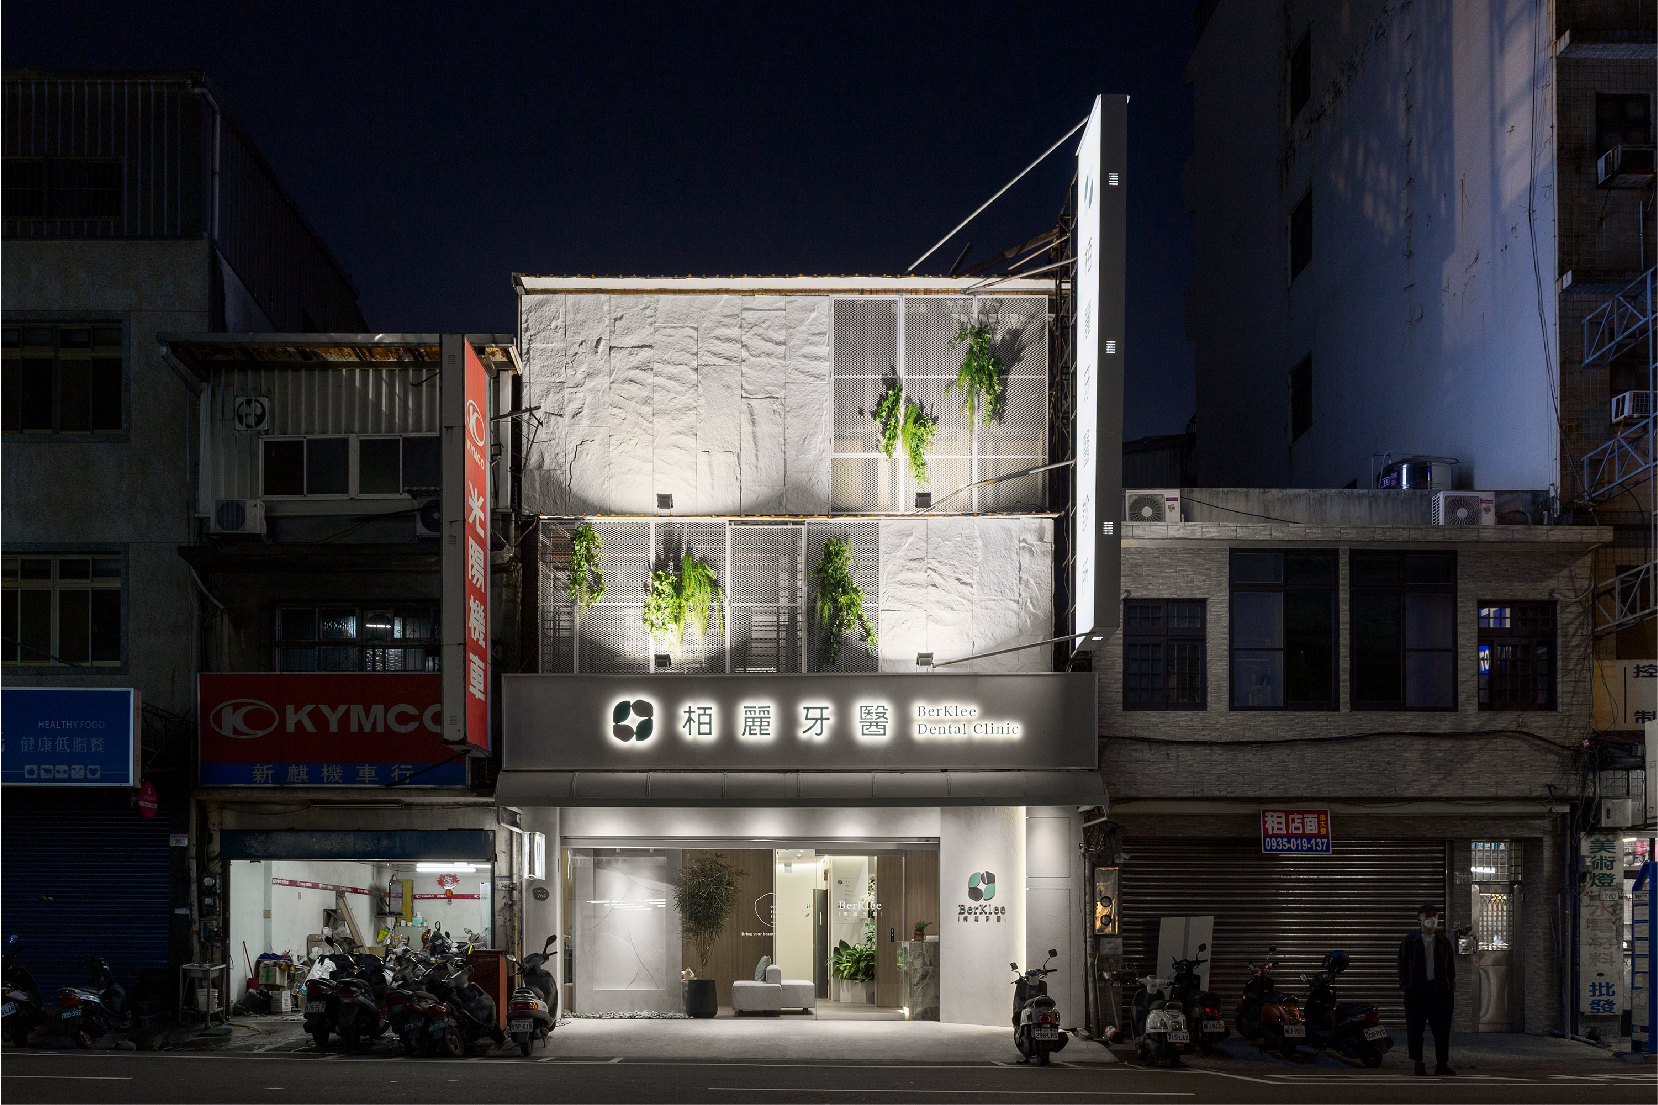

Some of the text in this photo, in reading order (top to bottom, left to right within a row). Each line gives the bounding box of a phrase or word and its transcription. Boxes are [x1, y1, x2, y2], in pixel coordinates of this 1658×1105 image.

[467, 439, 485, 470] KYMCO
[467, 480, 486, 702] 光陽機車
[916, 705, 977, 718] BerKlee
[38, 720, 106, 729] HEALTHY FOOD
[916, 722, 1020, 736] Dental Clinic
[20, 736, 105, 753] 健康低脂餐
[1264, 811, 1319, 835] 租店面
[1265, 837, 1328, 851] 0935-019-137
[1589, 838, 1617, 888] 美術燈
[838, 900, 883, 911] BerKlee
[957, 904, 1007, 916] BerKlee
[1588, 981, 1616, 1014] 批發
